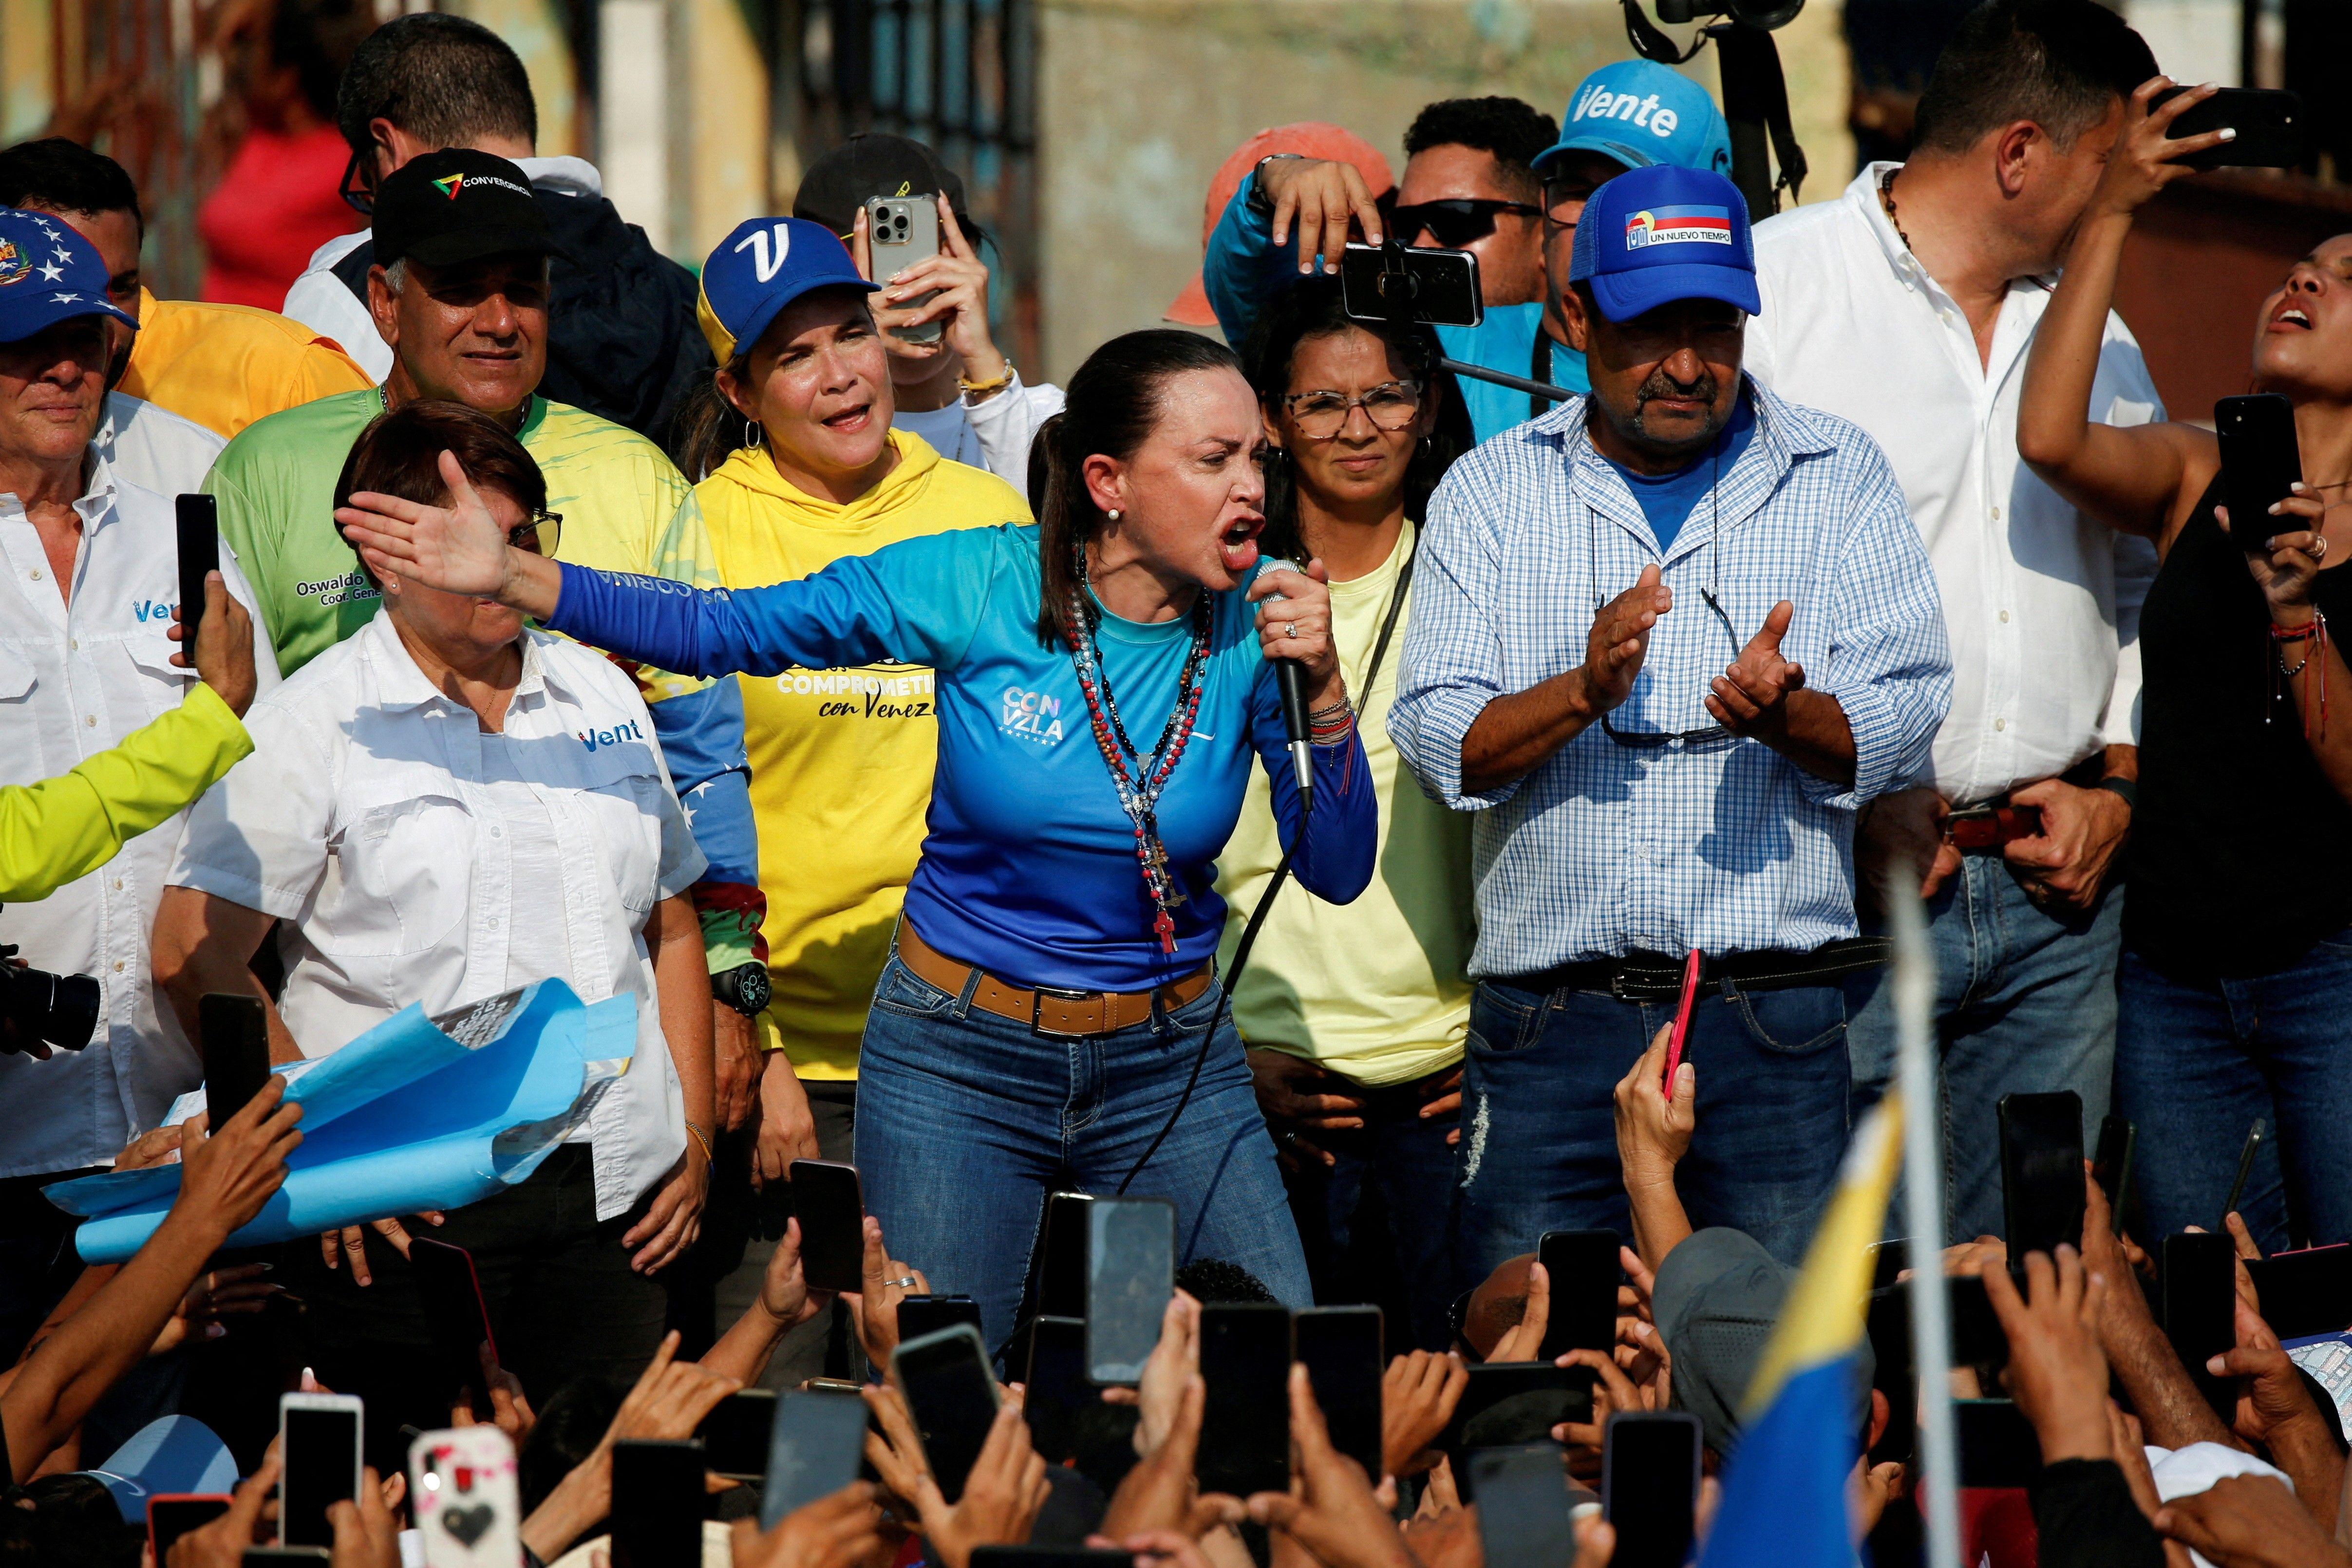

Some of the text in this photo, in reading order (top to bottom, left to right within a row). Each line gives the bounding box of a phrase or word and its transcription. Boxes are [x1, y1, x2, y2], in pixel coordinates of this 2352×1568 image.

[1572, 84, 1678, 137] Vente
[463, 176, 532, 198] CONVERGENCIA
[1651, 231, 1730, 243] UN NUEVO TIEMPO
[734, 223, 790, 283] V
[296, 572, 364, 597] Oswaldo
[594, 570, 692, 597] CORINA
[320, 592, 350, 606] Coor.
[819, 702, 860, 717] con
[1003, 686, 1061, 718] CON
[1003, 704, 1063, 741] VZLA
